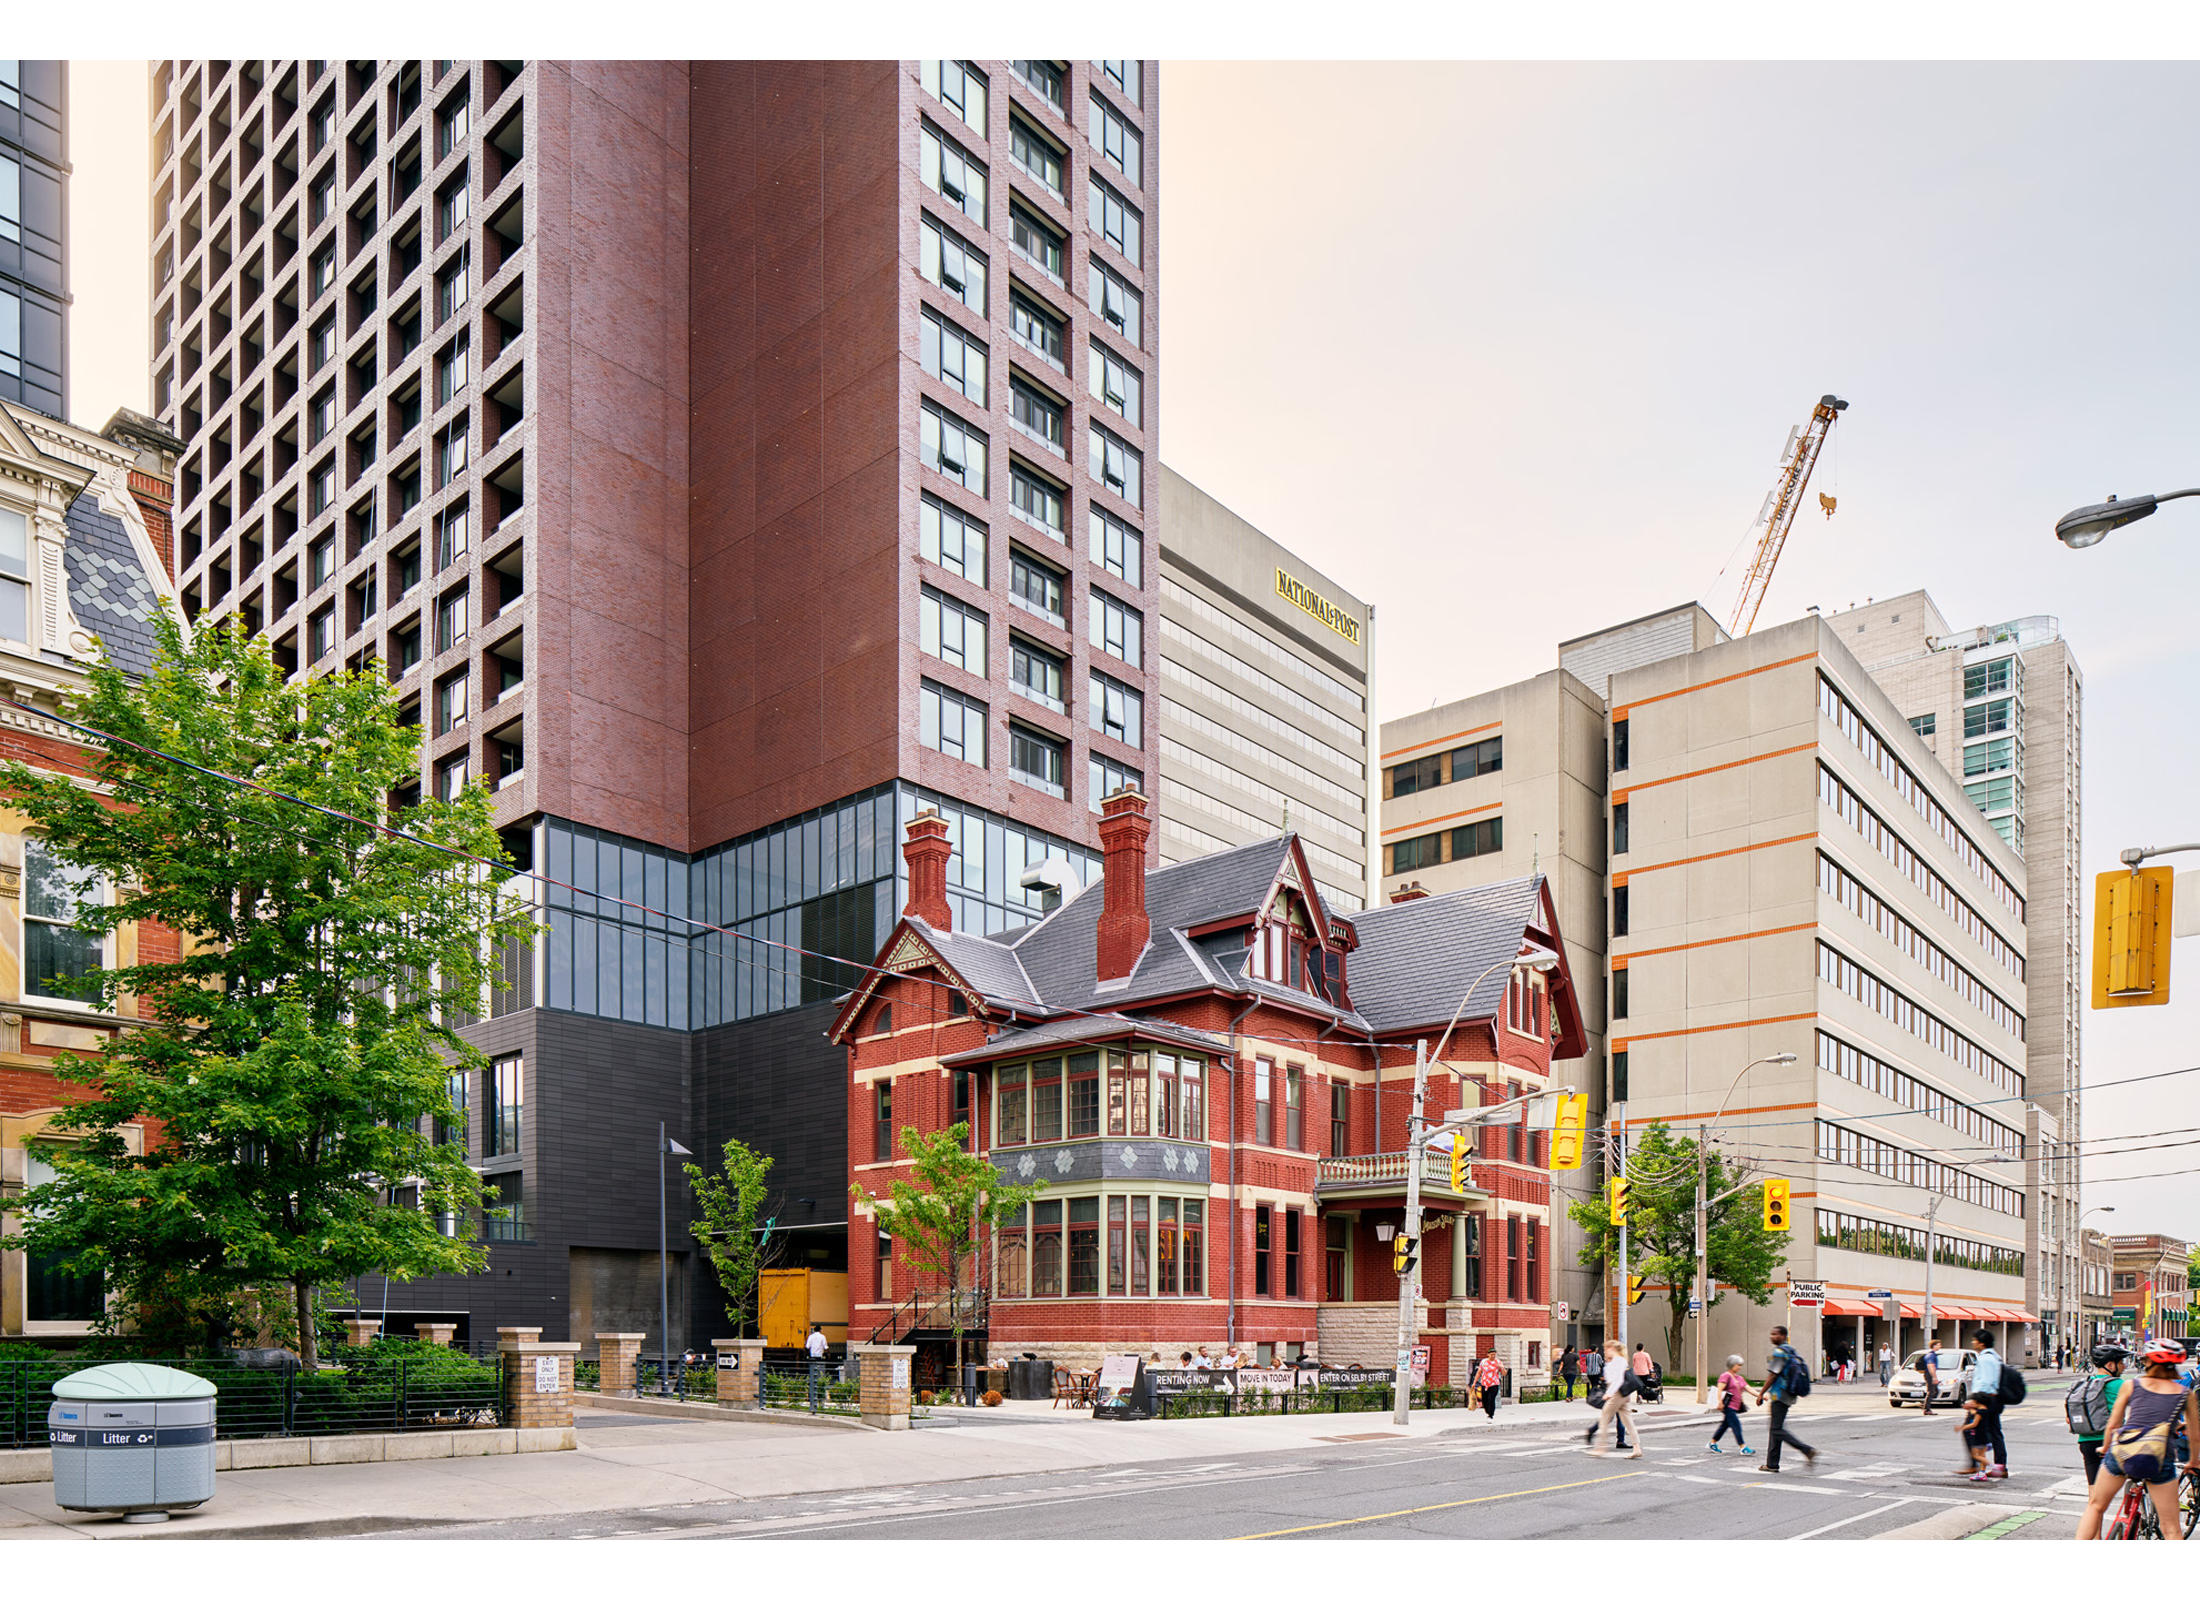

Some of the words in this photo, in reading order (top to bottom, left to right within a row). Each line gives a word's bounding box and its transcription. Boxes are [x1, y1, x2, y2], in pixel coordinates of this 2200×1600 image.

[1278, 569, 1333, 625] NATIONAL
[1334, 607, 1359, 642] POST
[1794, 1283, 1822, 1291] PUBLIC
[1790, 1291, 1825, 1299] PARKING
[1156, 1375, 1192, 1385] RENTING
[1192, 1374, 1211, 1384] NOW
[1240, 1374, 1260, 1383] MOVE
[1261, 1374, 1268, 1382] IN
[1269, 1374, 1292, 1383] TODAY
[1320, 1374, 1340, 1382] ENTER
[1341, 1373, 1350, 1382] ON
[1351, 1374, 1367, 1382] SELBY
[1368, 1373, 1391, 1382] STREET
[57, 1431, 77, 1443] Litter
[103, 1433, 130, 1444] Litter
